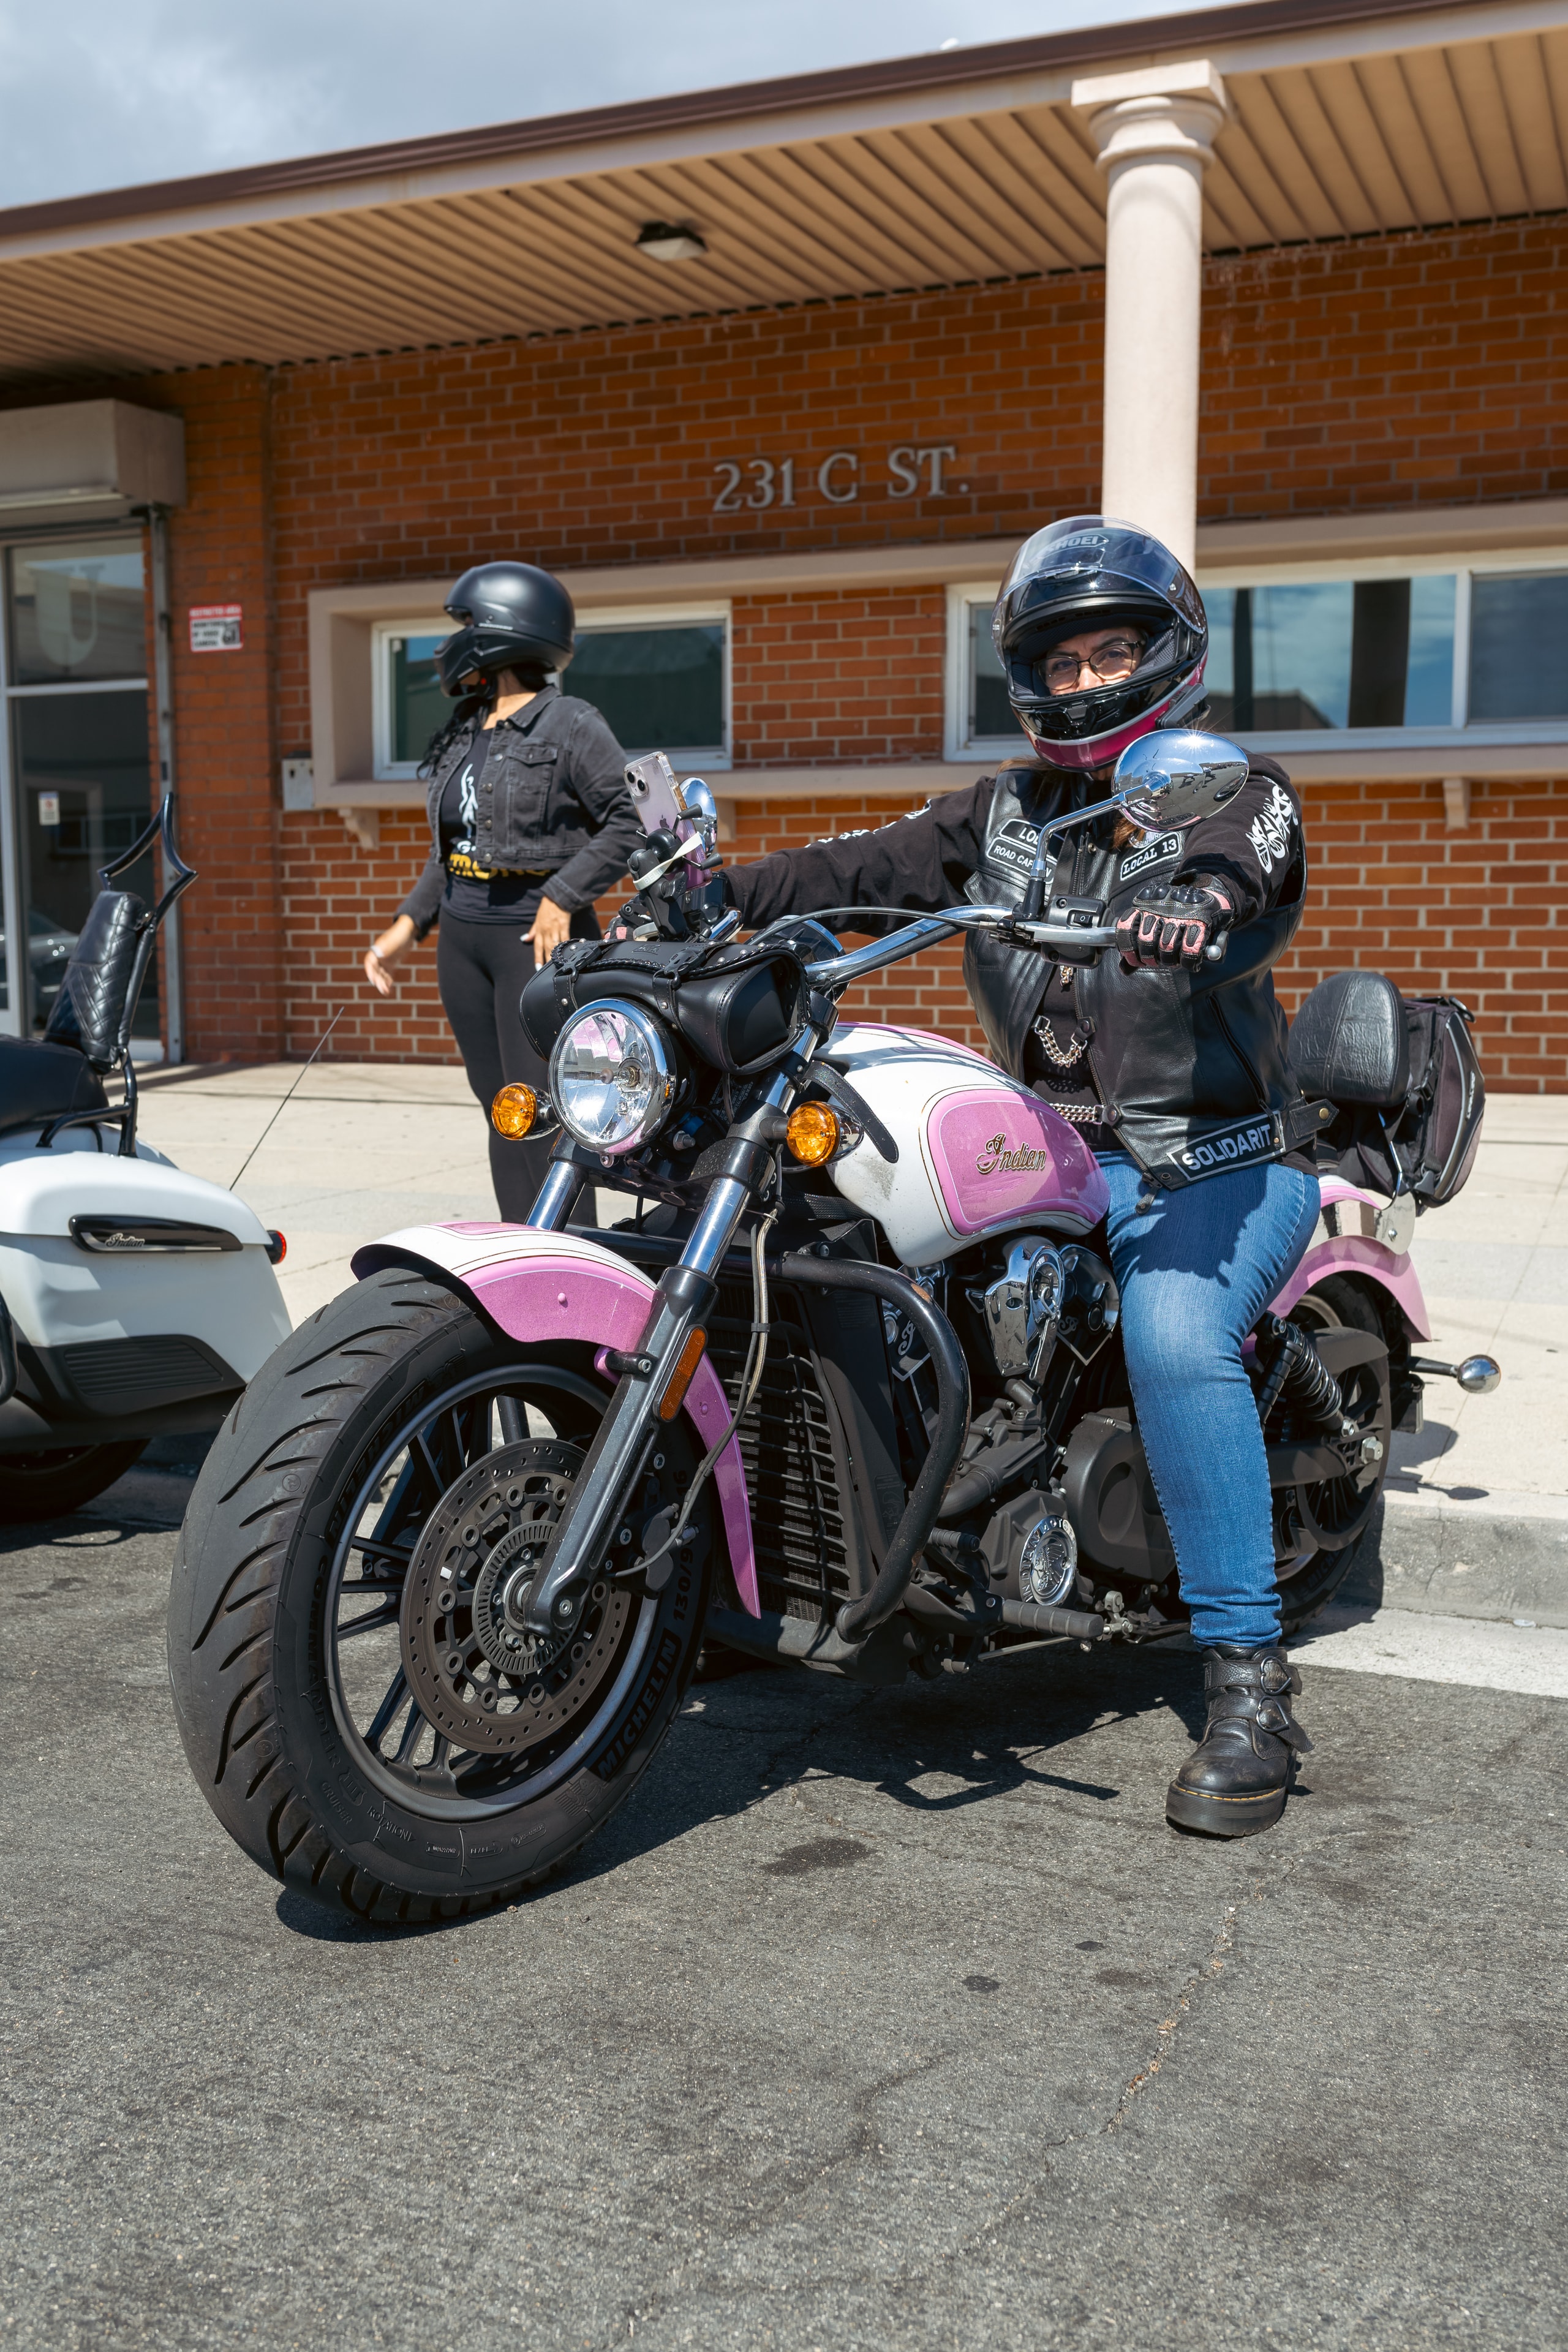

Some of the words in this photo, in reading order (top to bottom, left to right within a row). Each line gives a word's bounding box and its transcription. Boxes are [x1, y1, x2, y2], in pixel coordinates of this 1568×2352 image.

[712, 457, 796, 512] 231
[818, 452, 858, 503] C
[886, 445, 969, 498] ST.
[993, 845, 1016, 860] ROAD
[1019, 827, 1039, 845] LOL
[1123, 848, 1158, 875] LOCAL
[1163, 839, 1177, 853] 13
[975, 1132, 1046, 1175] Indian
[1182, 1123, 1272, 1170] SOLIDARIT
[105, 1232, 145, 1247] Indian
[597, 1637, 677, 1777] MICHELIN
[321, 1781, 353, 1825] CRUISER
[367, 1805, 413, 1842] ROTATION
